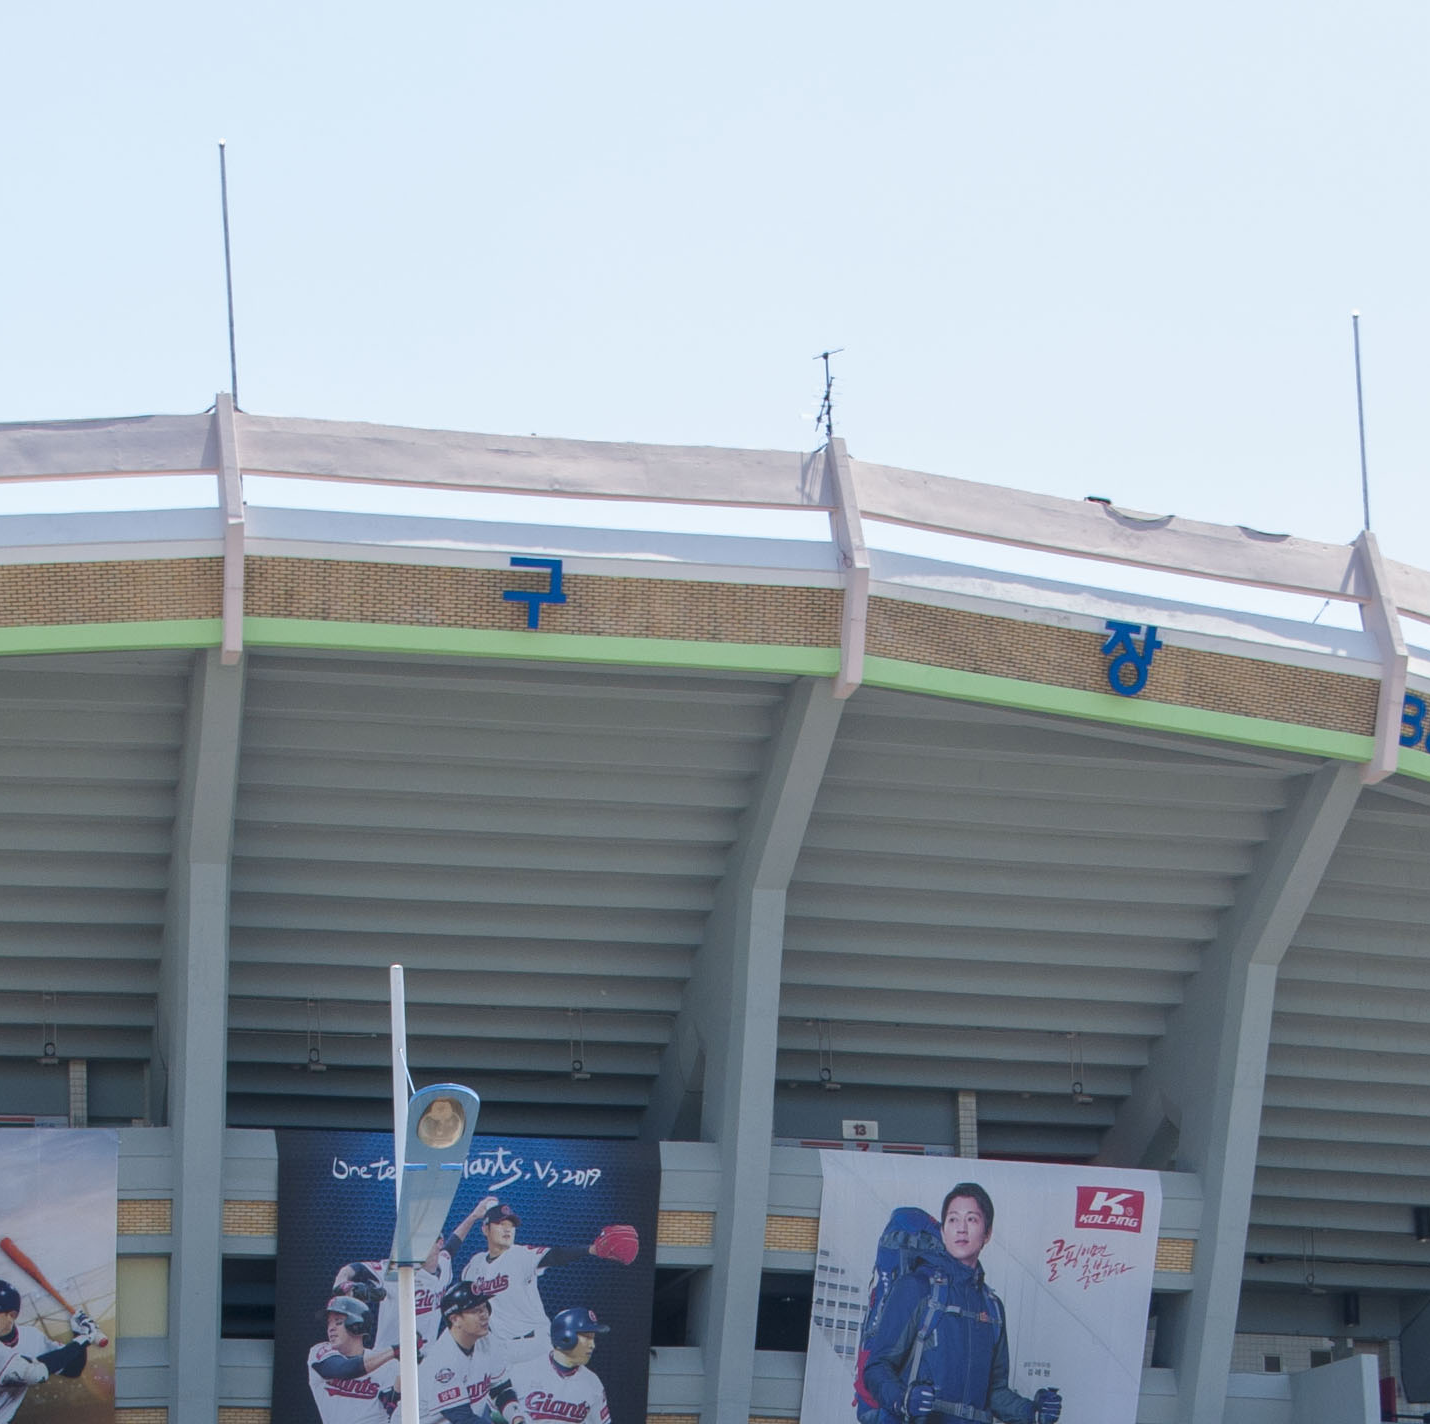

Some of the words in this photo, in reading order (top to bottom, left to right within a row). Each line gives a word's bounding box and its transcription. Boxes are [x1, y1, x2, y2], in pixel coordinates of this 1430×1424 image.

[503, 557, 566, 629] 구
[1101, 620, 1162, 696] 장
[852, 1124, 867, 1136] 13
[332, 1157, 368, 1180] One
[463, 1147, 530, 1192] iants,
[534, 1160, 559, 1187] V3
[561, 1168, 602, 1189] 2019
[1089, 1191, 1134, 1215] K
[1079, 1214, 1140, 1227] KOLPING
[526, 1391, 590, 1418] Giants
